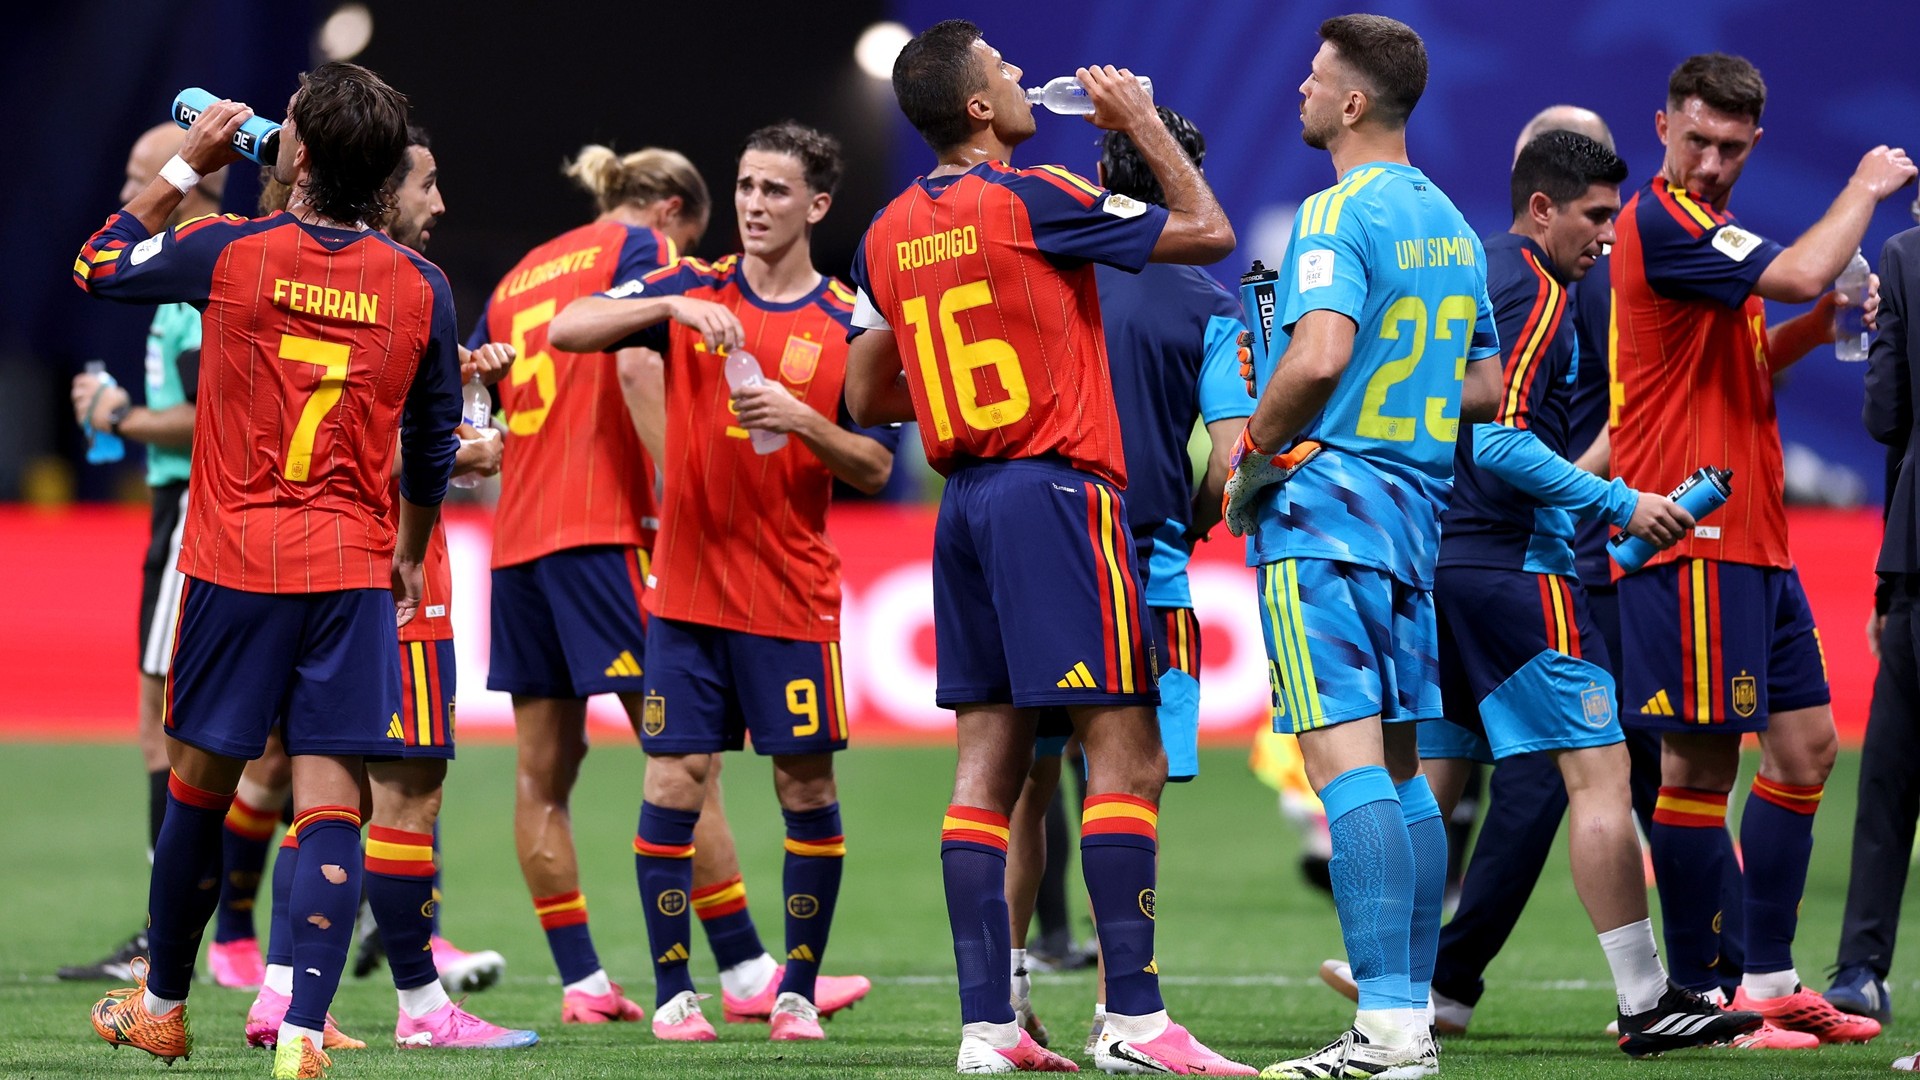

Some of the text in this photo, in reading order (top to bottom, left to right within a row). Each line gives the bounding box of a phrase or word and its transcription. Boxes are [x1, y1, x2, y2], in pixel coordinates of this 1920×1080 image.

[273, 278, 378, 324] FERRAN
[896, 225, 977, 272] RODRIGO
[278, 333, 351, 482] 7
[509, 299, 557, 436] 5
[902, 279, 1031, 442] 16
[1355, 294, 1478, 443] 23
[786, 678, 820, 737] 9
